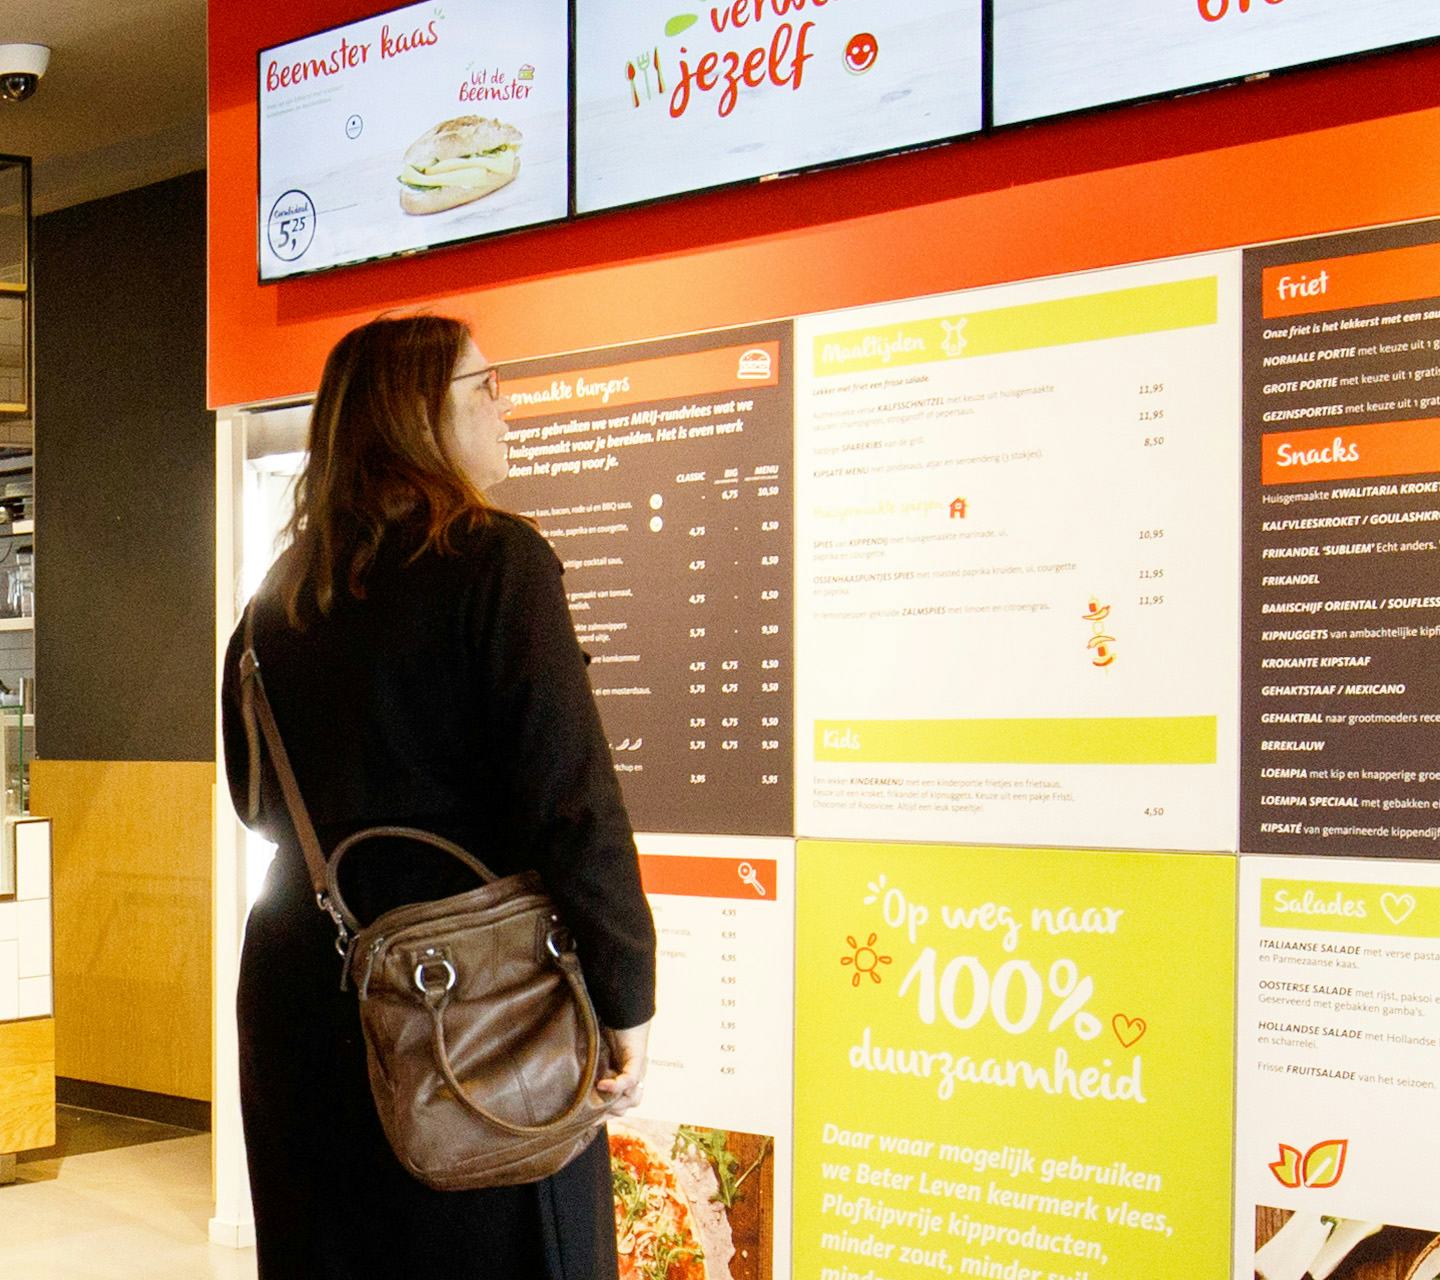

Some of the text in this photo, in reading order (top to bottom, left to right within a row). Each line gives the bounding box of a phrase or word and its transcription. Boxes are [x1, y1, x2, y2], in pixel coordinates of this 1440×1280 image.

[266, 20, 439, 93] Beemster kaas
[470, 67, 505, 86] Uit de
[669, 21, 817, 118] jezelf
[459, 78, 533, 102] Beemster
[822, 333, 925, 363] Maaltijden
[1263, 347, 1356, 367] NORMALE PORTIE
[576, 377, 630, 404] burgers
[1263, 405, 1343, 422] GEZINSPORTIES
[1276, 437, 1360, 467] Snacks
[676, 472, 706, 483] CLASSIC
[1139, 529, 1164, 540] 10,95
[1262, 515, 1361, 532] KALFVLEESKROKET
[1262, 546, 1320, 559] FRIKANDEL
[823, 728, 862, 750] Kids
[1261, 741, 1325, 751] BEREKLAUW
[1261, 768, 1308, 779] LOEMPIA
[1144, 807, 1164, 817] 4,50
[1261, 822, 1302, 835] KIPSATÉ
[1274, 889, 1367, 919] Salades
[883, 888, 1125, 952] Op weg naar
[898, 947, 1104, 1042] 100%
[849, 1027, 1147, 1104] duurzaamheid
[822, 1122, 1163, 1193] Daar waar mogelijk gebruiken
[821, 1163, 1173, 1238] we Beter Leven keurmerk vlees,
[822, 1194, 1110, 1265] Plofkipvrije kipproducten,
[821, 1230, 894, 1261] minder
[900, 1245, 954, 1274] zout,
